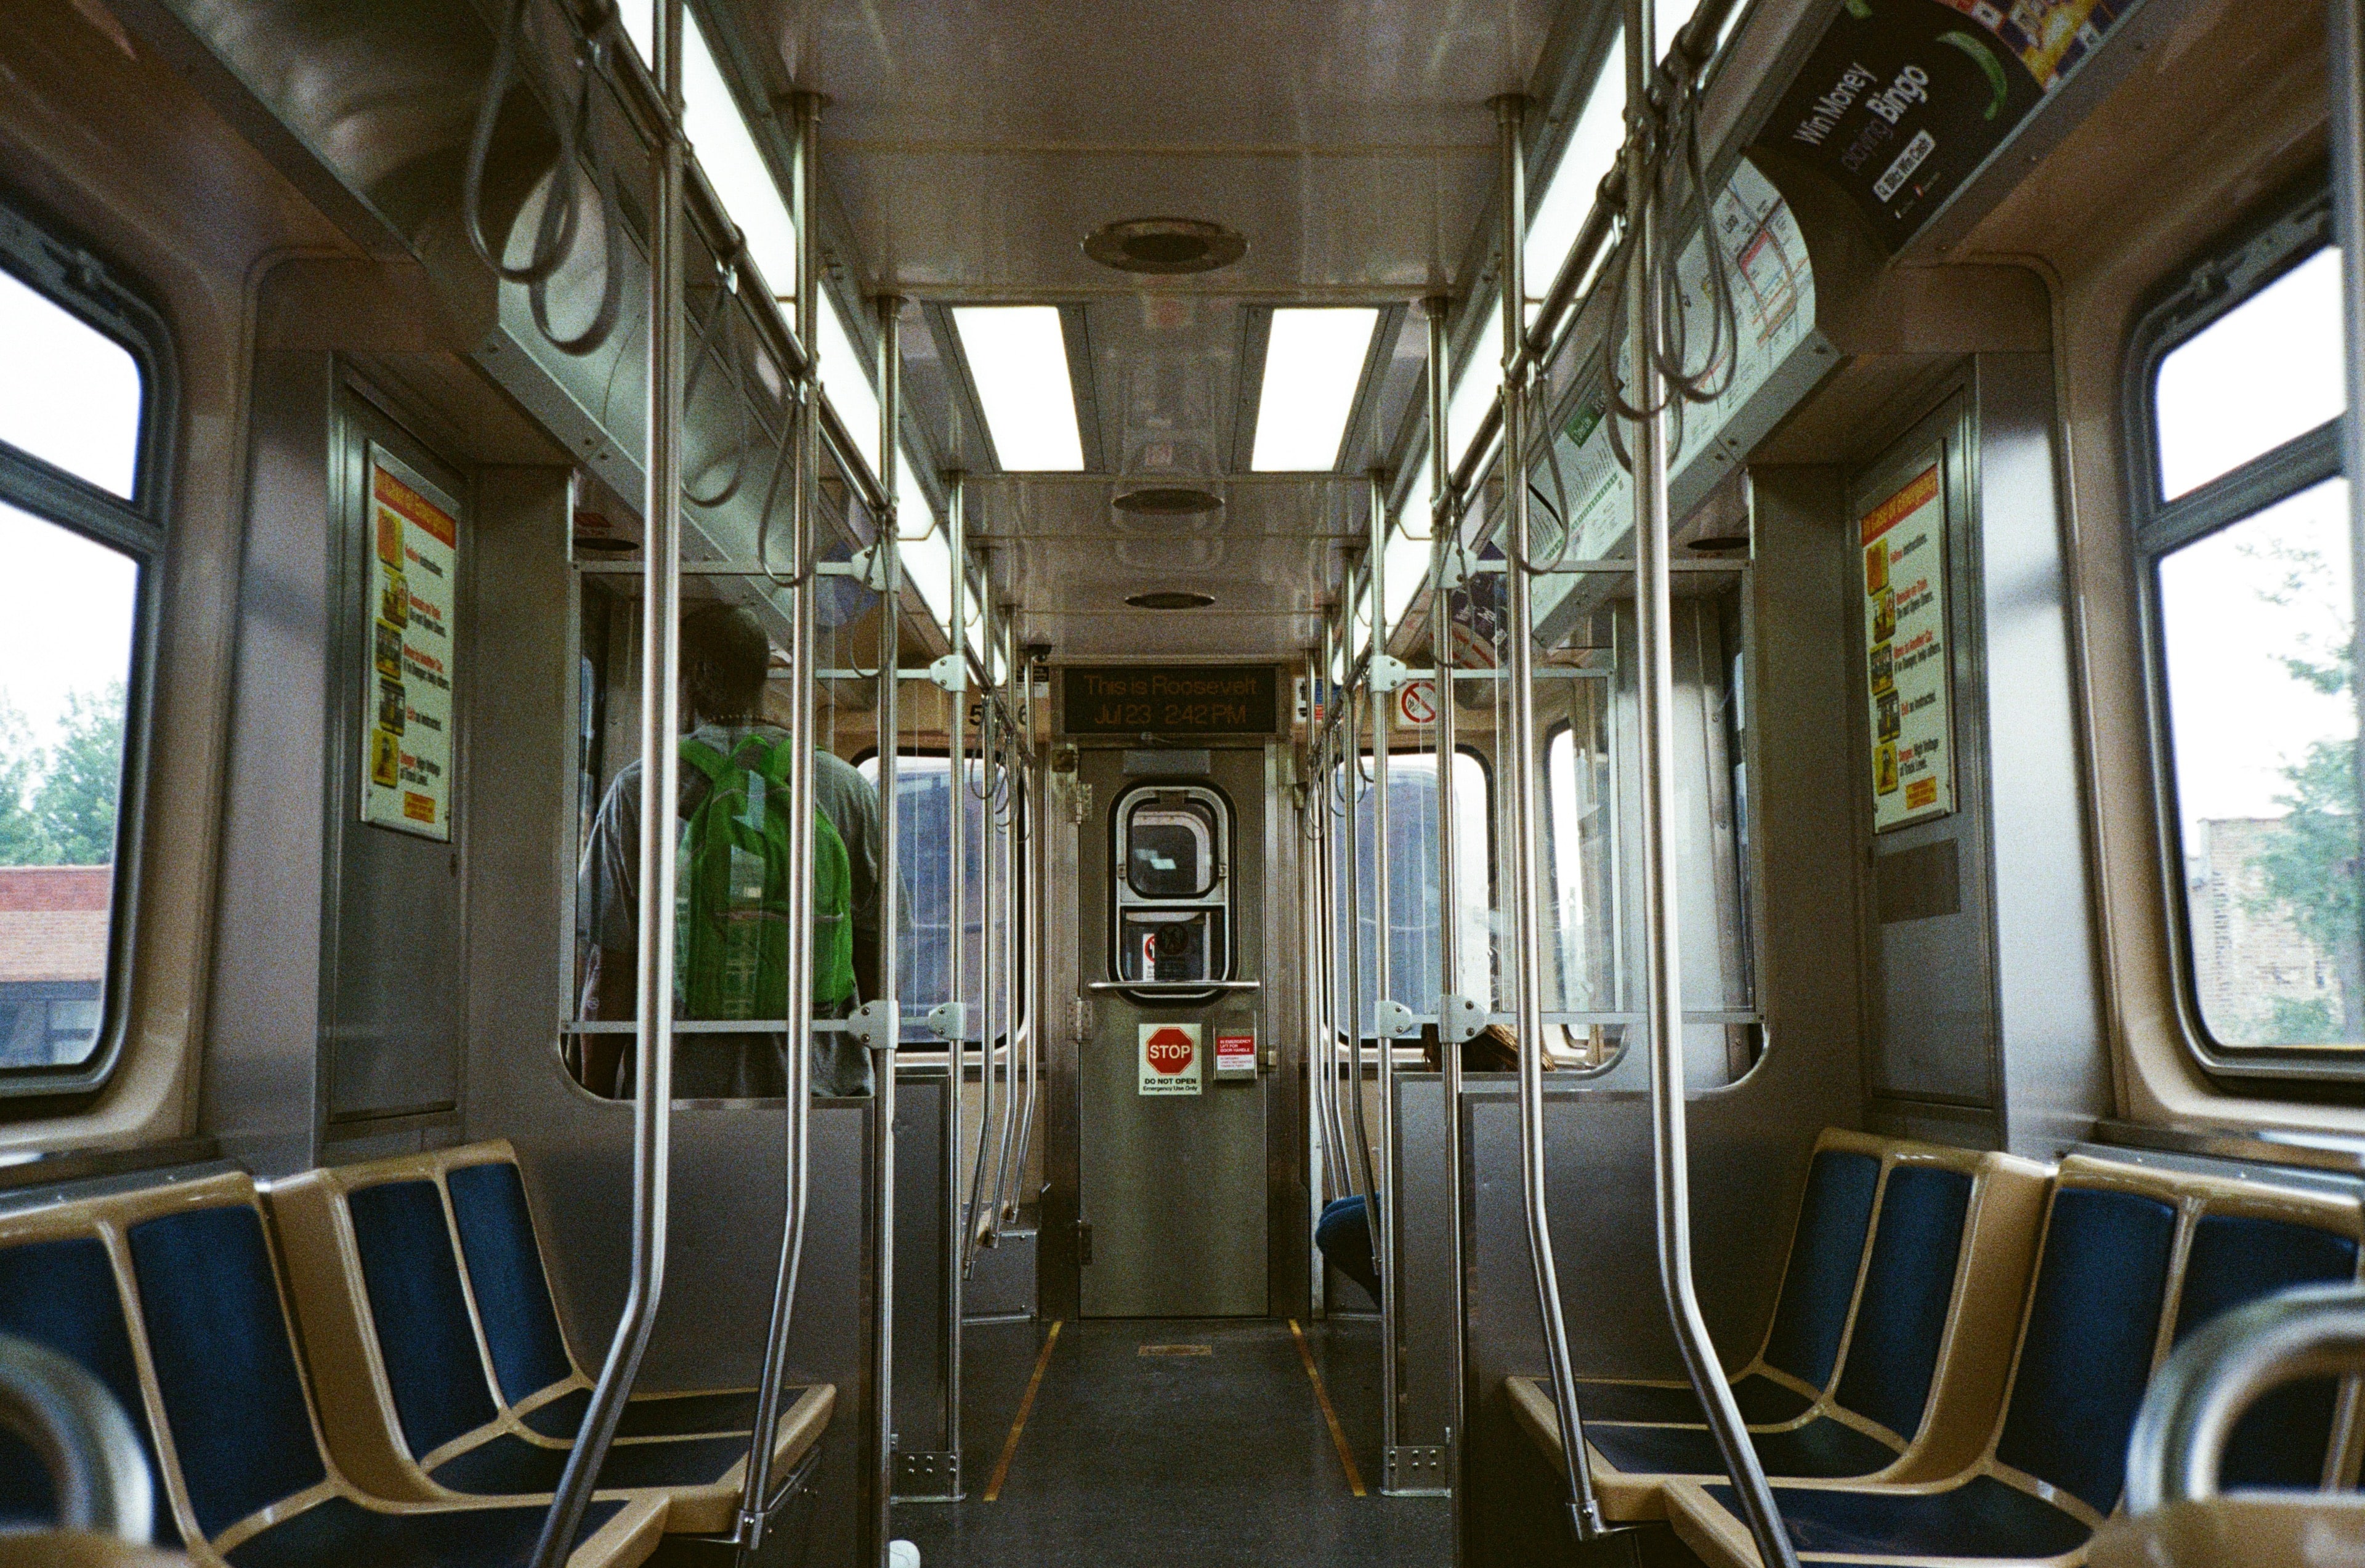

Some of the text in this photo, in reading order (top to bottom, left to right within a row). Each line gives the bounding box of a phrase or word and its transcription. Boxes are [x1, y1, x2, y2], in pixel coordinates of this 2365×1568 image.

[1792, 62, 1878, 146] Win Money
[1865, 65, 1930, 125] Bingo
[1083, 674, 1258, 695] This is Roosevelt
[969, 705, 985, 726] 5
[1094, 703, 1122, 725] Jul
[1125, 703, 1152, 725] 23
[1211, 703, 1247, 725] PM
[1149, 1044, 1192, 1060] STOP
